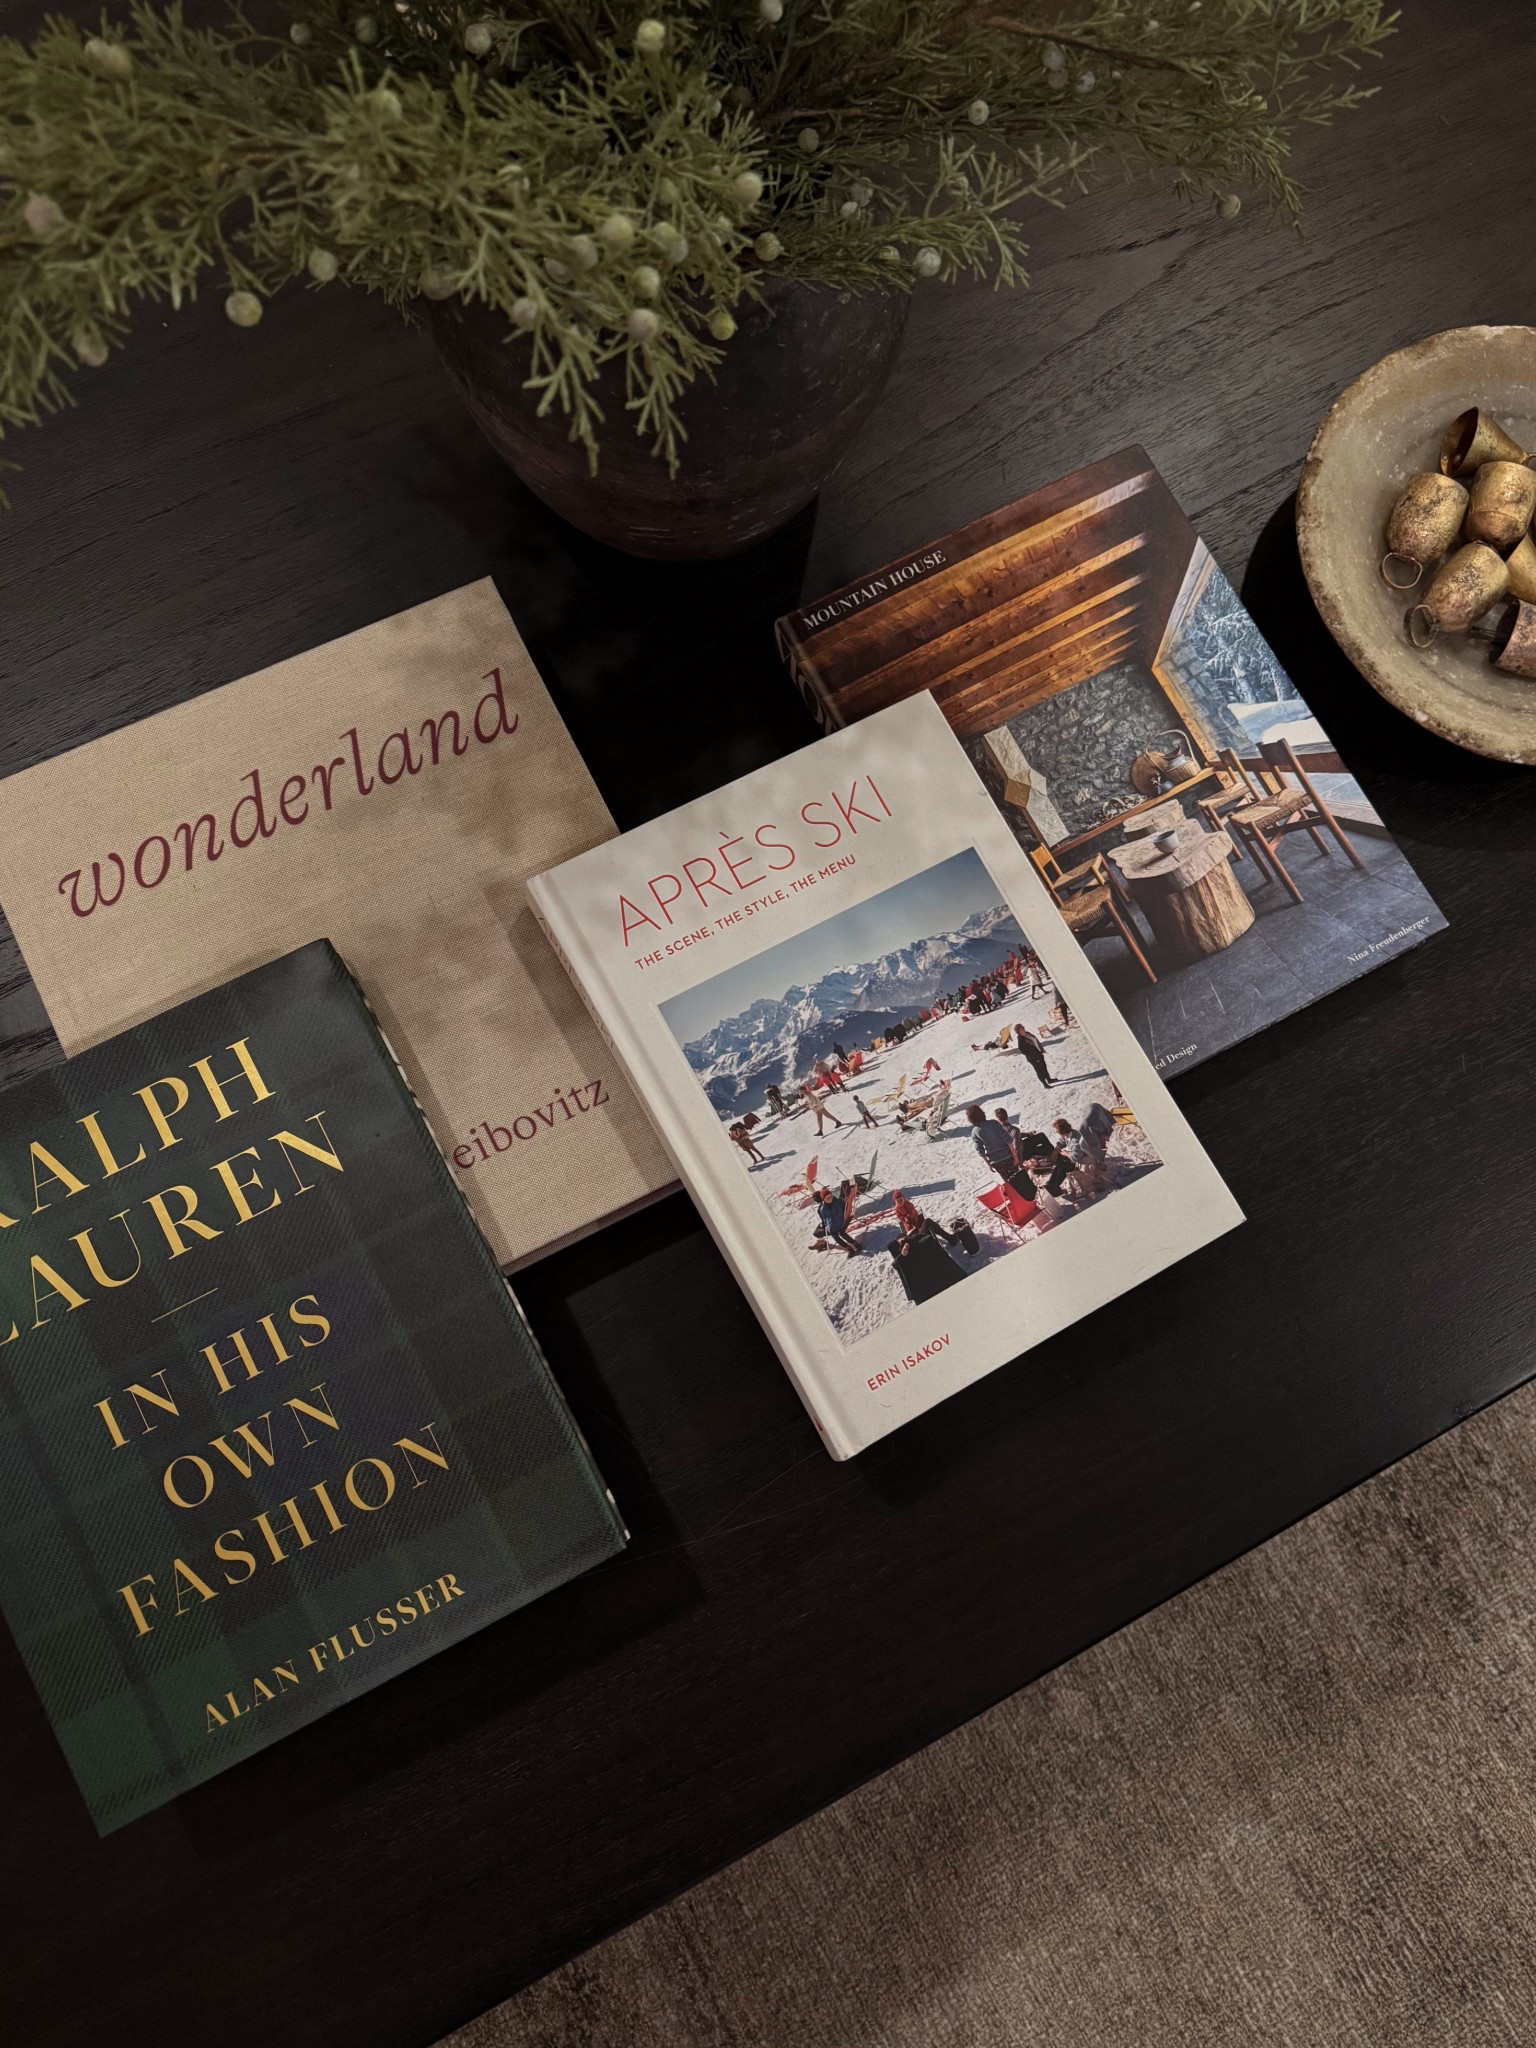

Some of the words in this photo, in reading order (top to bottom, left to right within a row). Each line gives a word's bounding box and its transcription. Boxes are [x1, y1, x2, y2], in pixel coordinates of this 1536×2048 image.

[802, 578, 889, 631] MOUNTAIN
[889, 549, 947, 587] HOUSE
[57, 667, 519, 918] wonderland
[618, 824, 796, 947] APRÈS
[801, 774, 892, 849] SKI
[634, 949, 664, 971] THE
[665, 926, 716, 956] SCENE,
[714, 910, 744, 931] THE
[744, 889, 790, 917] STYLE,
[788, 873, 818, 894] THE
[817, 853, 857, 881] MENU
[1346, 950, 1370, 965] Nina
[1368, 916, 1430, 953] Freudenberger
[1165, 1043, 1198, 1064] Design
[0, 1037, 277, 1230] ALPH
[452, 1079, 611, 1170] eibovitz
[0, 1111, 345, 1347] AUREN
[94, 1369, 181, 1450] IN
[200, 1294, 332, 1395] HIS
[866, 1363, 902, 1391] ERIN
[902, 1333, 950, 1370] ISAKOV
[163, 1383, 341, 1509] OWN
[116, 1423, 450, 1638] FASHION
[205, 1659, 301, 1733] ALAN
[307, 1571, 466, 1674] FLUSSER
